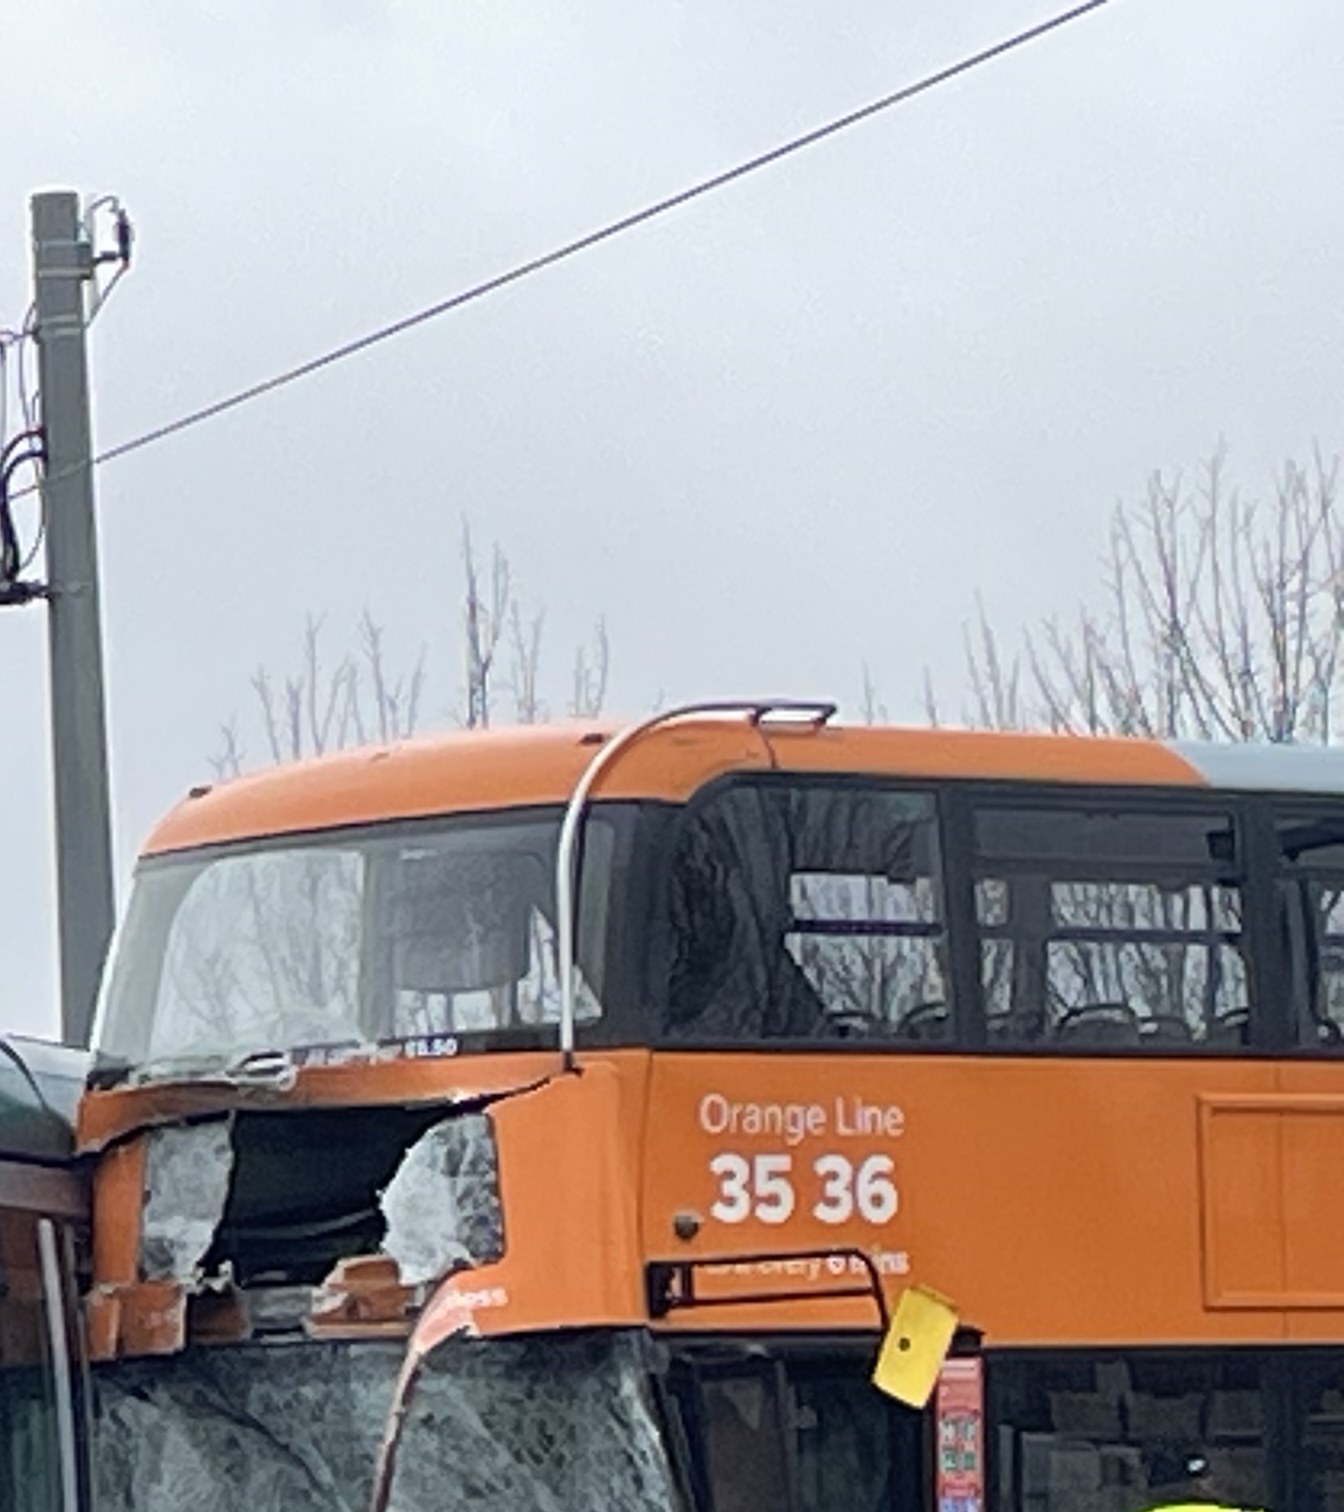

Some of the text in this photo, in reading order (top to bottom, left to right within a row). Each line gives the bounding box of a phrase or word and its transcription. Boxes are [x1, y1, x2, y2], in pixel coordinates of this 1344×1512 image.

[699, 1093, 905, 1146] Orange Line
[710, 1153, 898, 1225] 35 36
